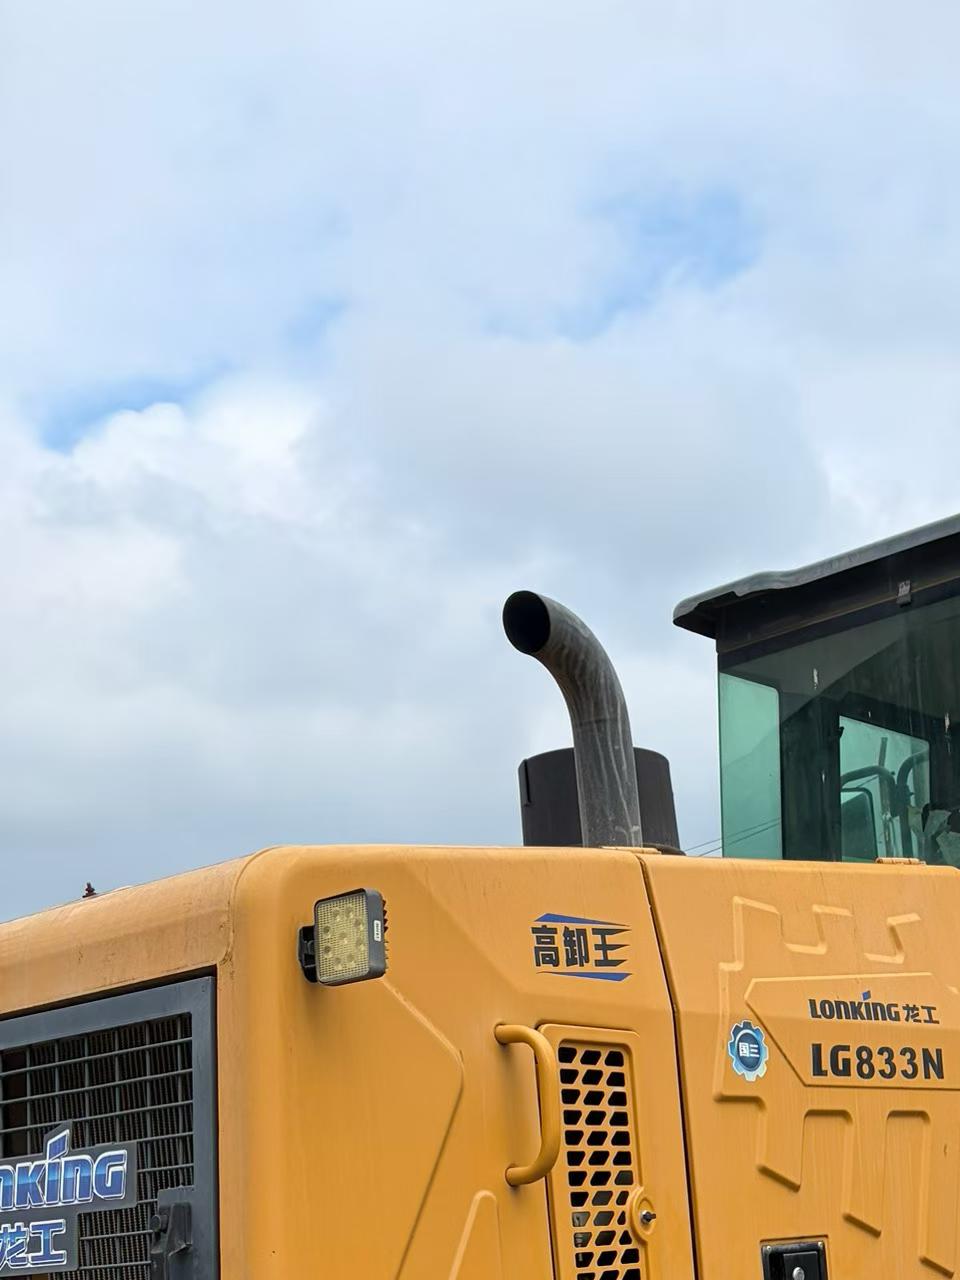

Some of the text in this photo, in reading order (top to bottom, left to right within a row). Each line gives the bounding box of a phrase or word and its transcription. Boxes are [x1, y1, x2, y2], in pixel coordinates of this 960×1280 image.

[530, 924, 632, 967] 高卸王
[902, 1003, 940, 1024] 龙工
[811, 1043, 945, 1080] LG833N
